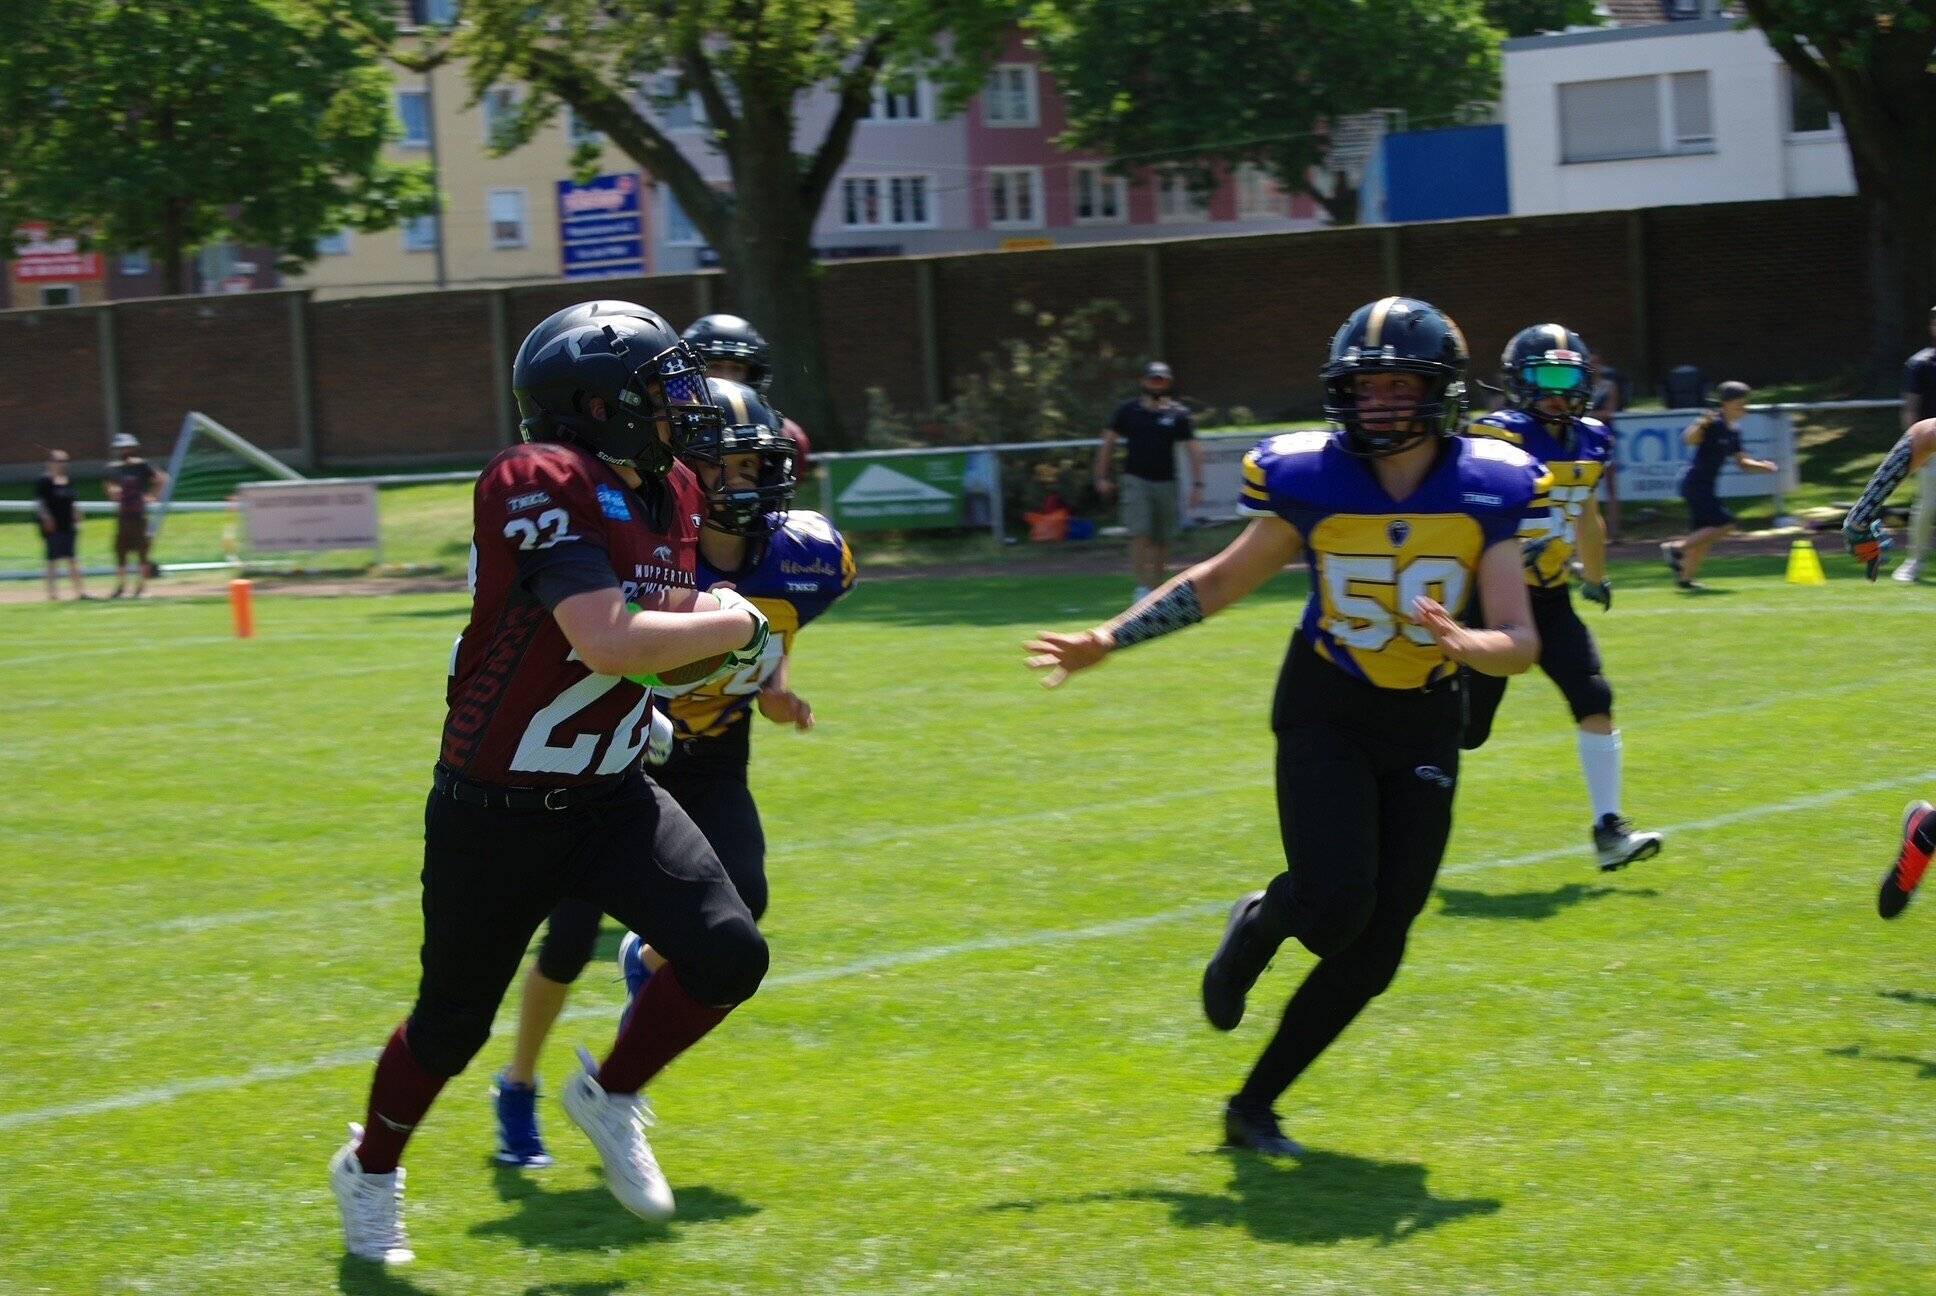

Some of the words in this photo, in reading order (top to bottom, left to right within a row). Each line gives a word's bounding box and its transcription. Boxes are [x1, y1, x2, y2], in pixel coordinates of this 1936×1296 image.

[503, 508, 582, 550] 22
[635, 564, 696, 585] WUPPERTAL
[1324, 553, 1470, 651] 59
